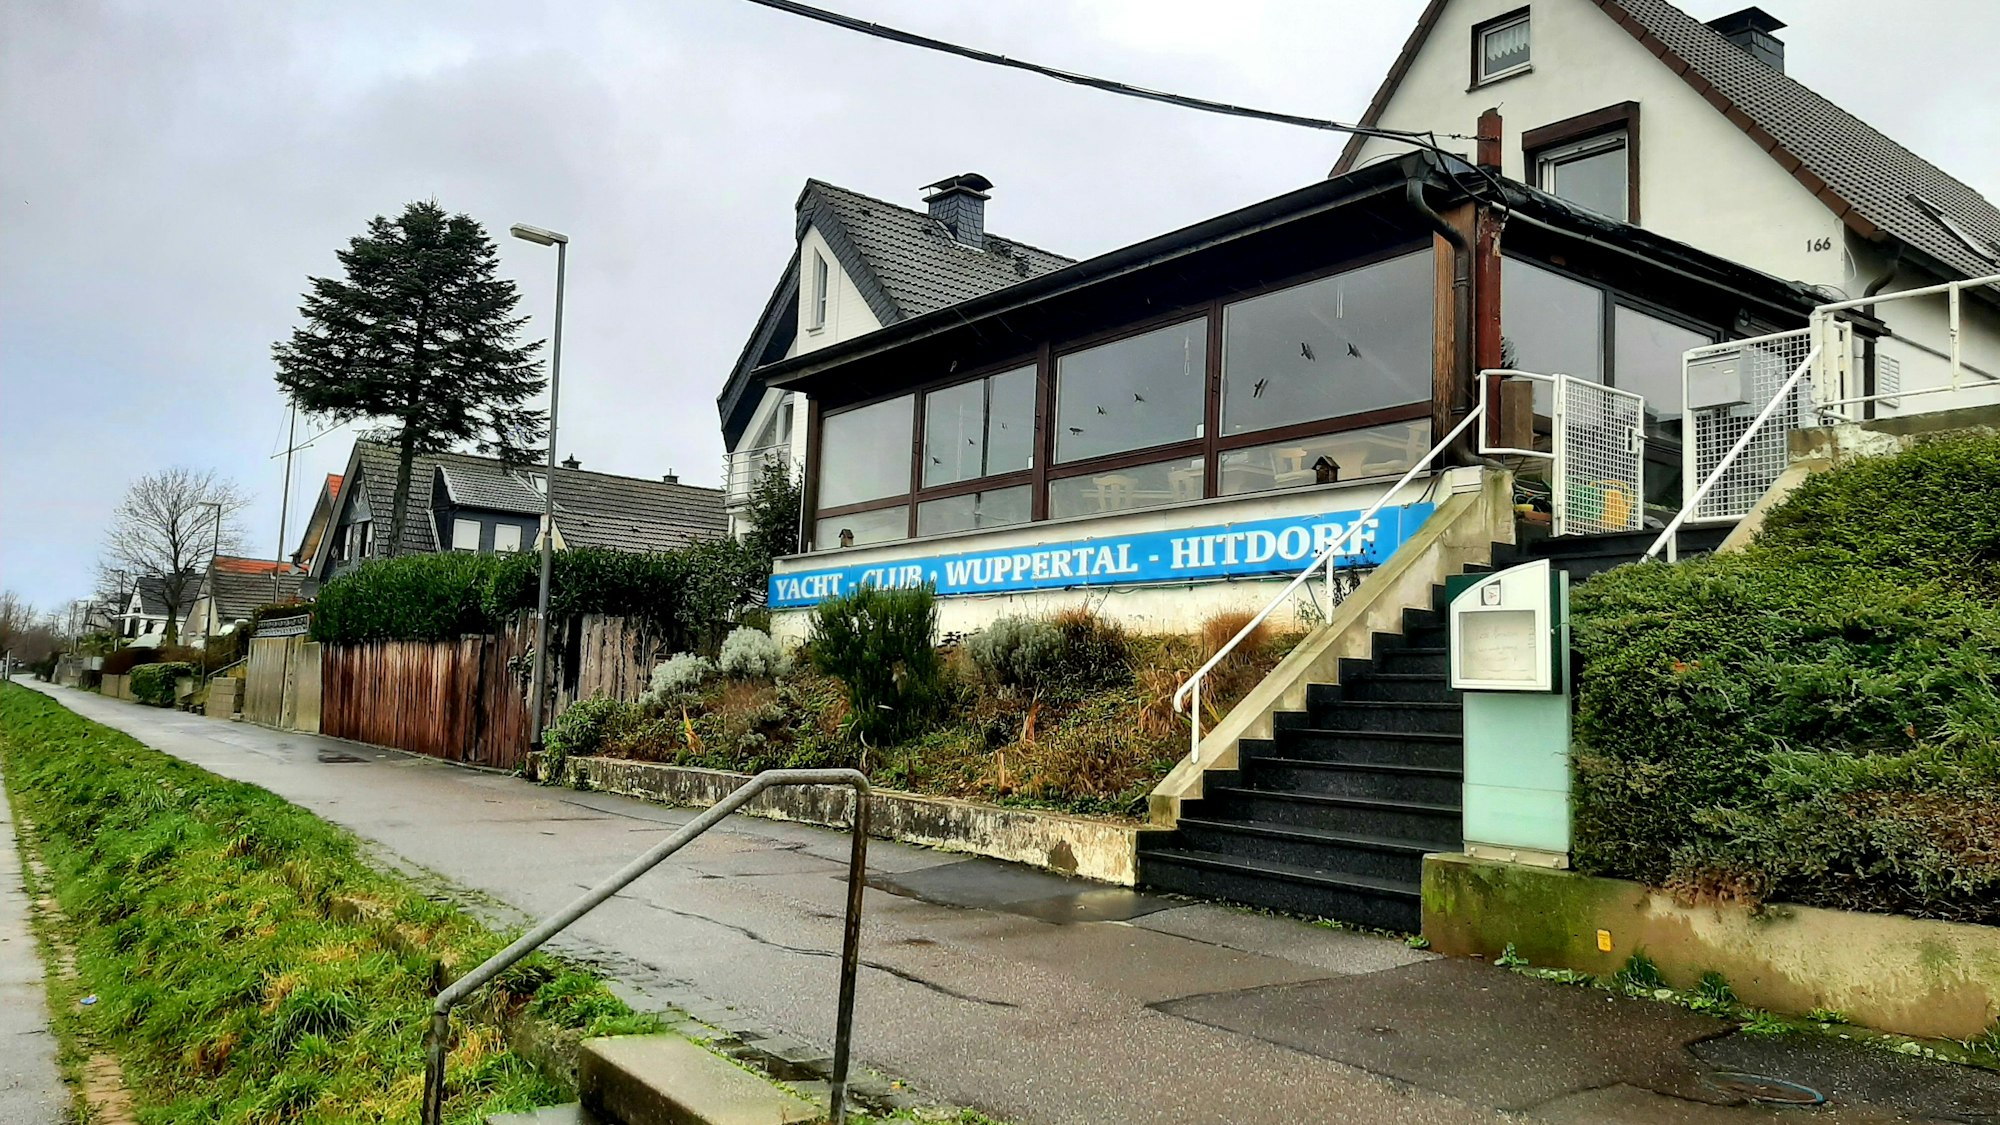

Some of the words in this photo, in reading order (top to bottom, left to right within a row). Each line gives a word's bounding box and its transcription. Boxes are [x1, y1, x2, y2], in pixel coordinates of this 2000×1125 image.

[1806, 237, 1831, 253] 166
[775, 573, 843, 601] YACHT
[861, 565, 922, 591] CLUB
[945, 543, 1138, 586] WUPPERTAL
[1170, 518, 1379, 569] HITDORF
